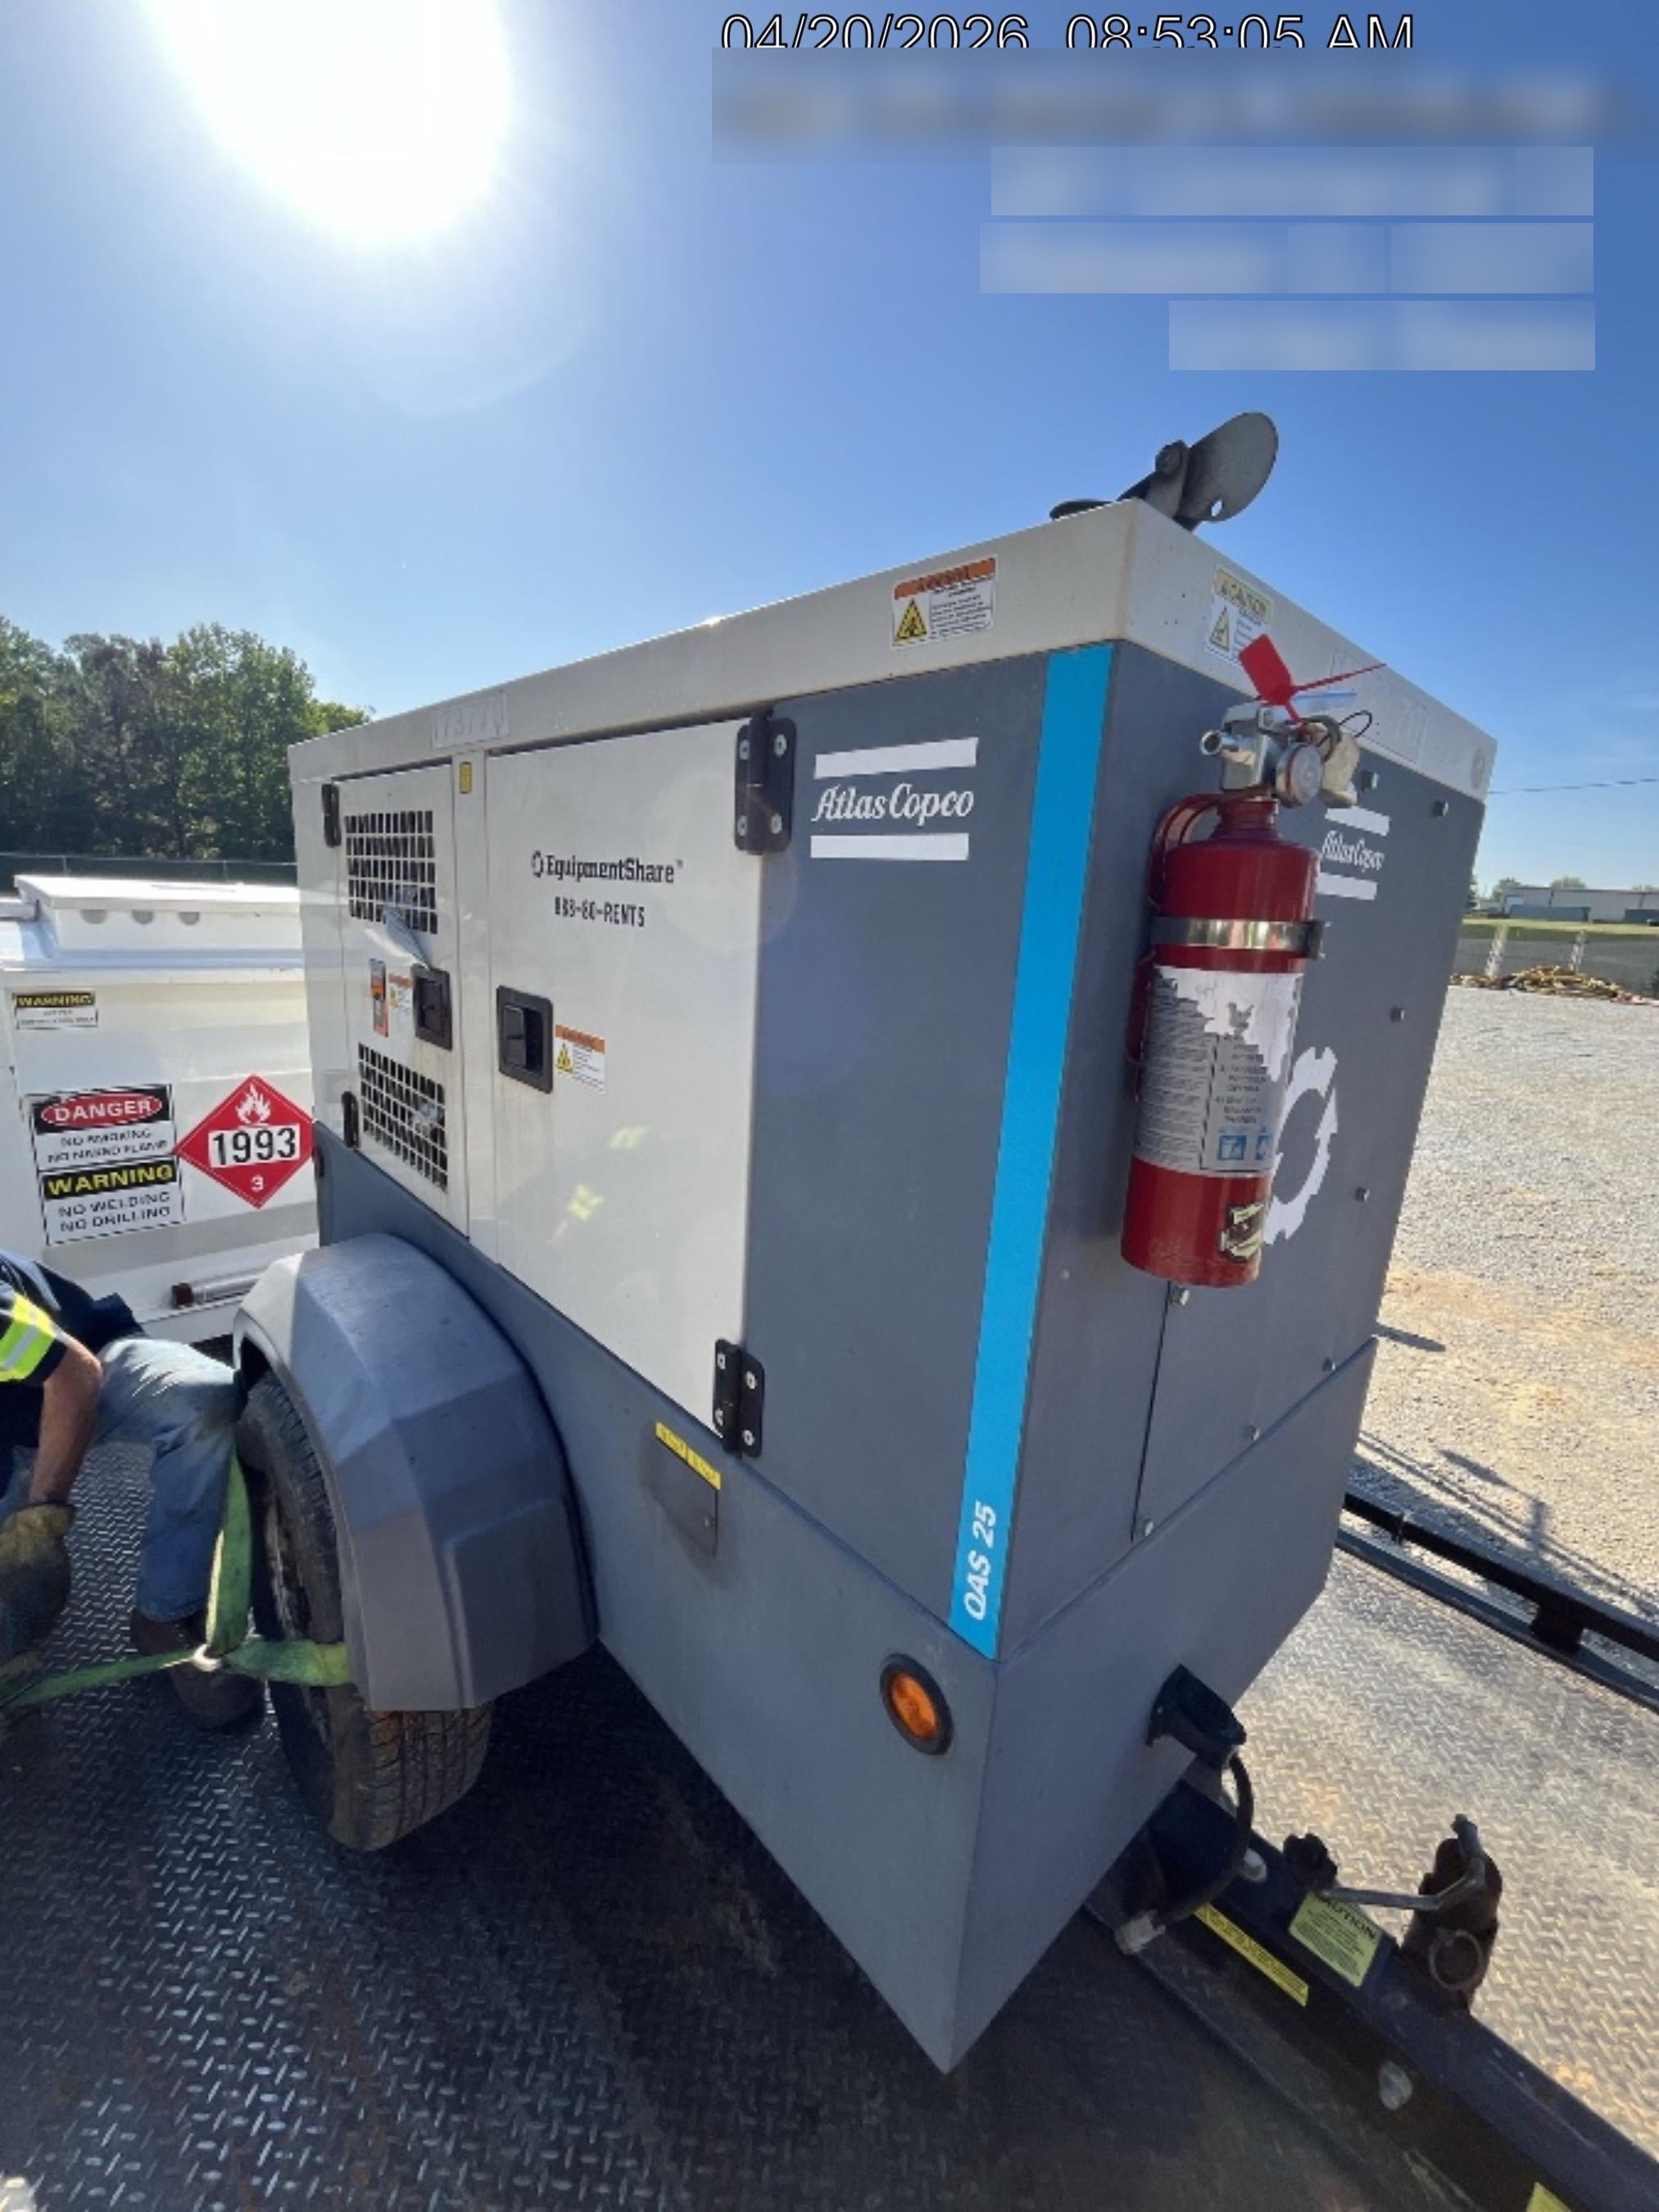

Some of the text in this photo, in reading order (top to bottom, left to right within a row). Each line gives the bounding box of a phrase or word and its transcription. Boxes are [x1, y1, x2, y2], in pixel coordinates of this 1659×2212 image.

[810, 782, 976, 827] Atlas Copco
[54, 1100, 152, 1122] DANGER
[213, 1127, 297, 1165] 1993
[48, 1164, 173, 1196] WARNING
[251, 1175, 264, 1193] 3
[59, 1191, 171, 1217] NO WELDING
[60, 1206, 171, 1232] NO DRILLING
[972, 1499, 996, 1548] 25
